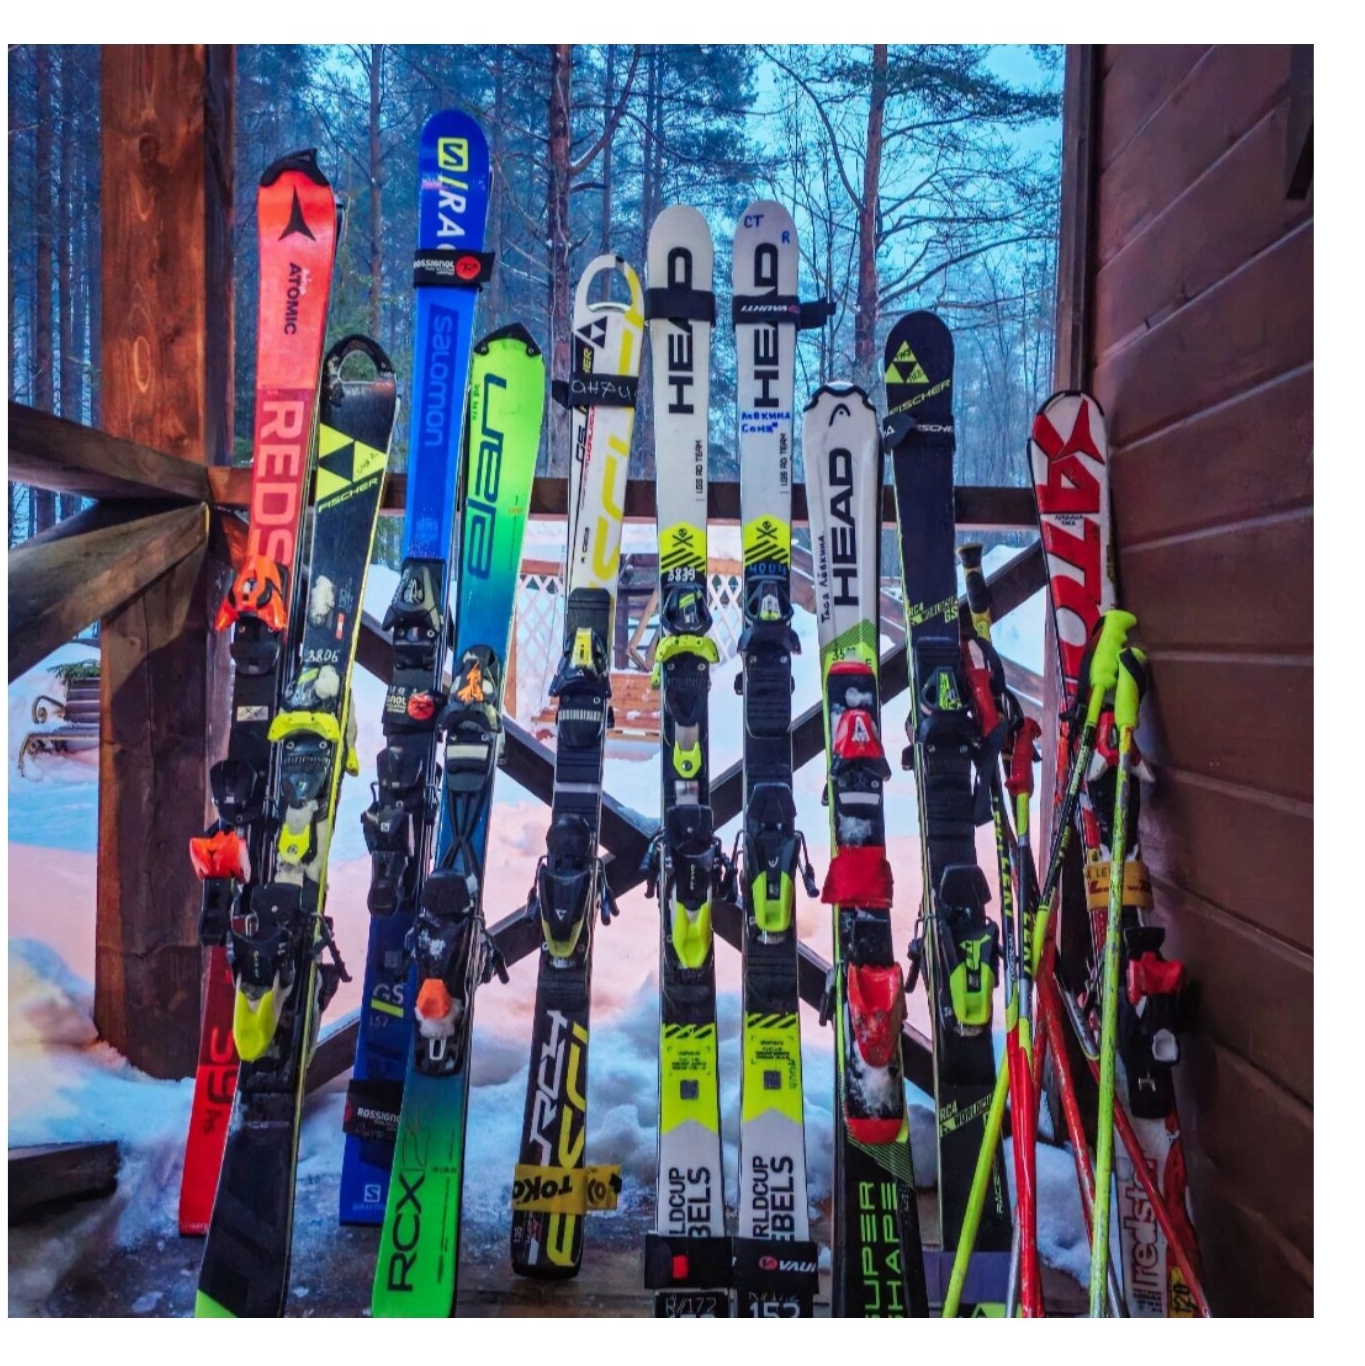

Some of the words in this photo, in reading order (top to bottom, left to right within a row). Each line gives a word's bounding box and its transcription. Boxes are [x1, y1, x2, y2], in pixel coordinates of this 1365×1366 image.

[283, 262, 302, 336] ATOMIC
[667, 246, 694, 414] HED
[754, 242, 779, 408] HED
[318, 477, 379, 514] FISCHER
[828, 448, 859, 606] HEAD
[387, 1172, 426, 1293] RCX
[669, 1166, 686, 1235] LDCUP
[860, 1182, 881, 1318] UPER
[881, 1182, 904, 1318] HAPE
